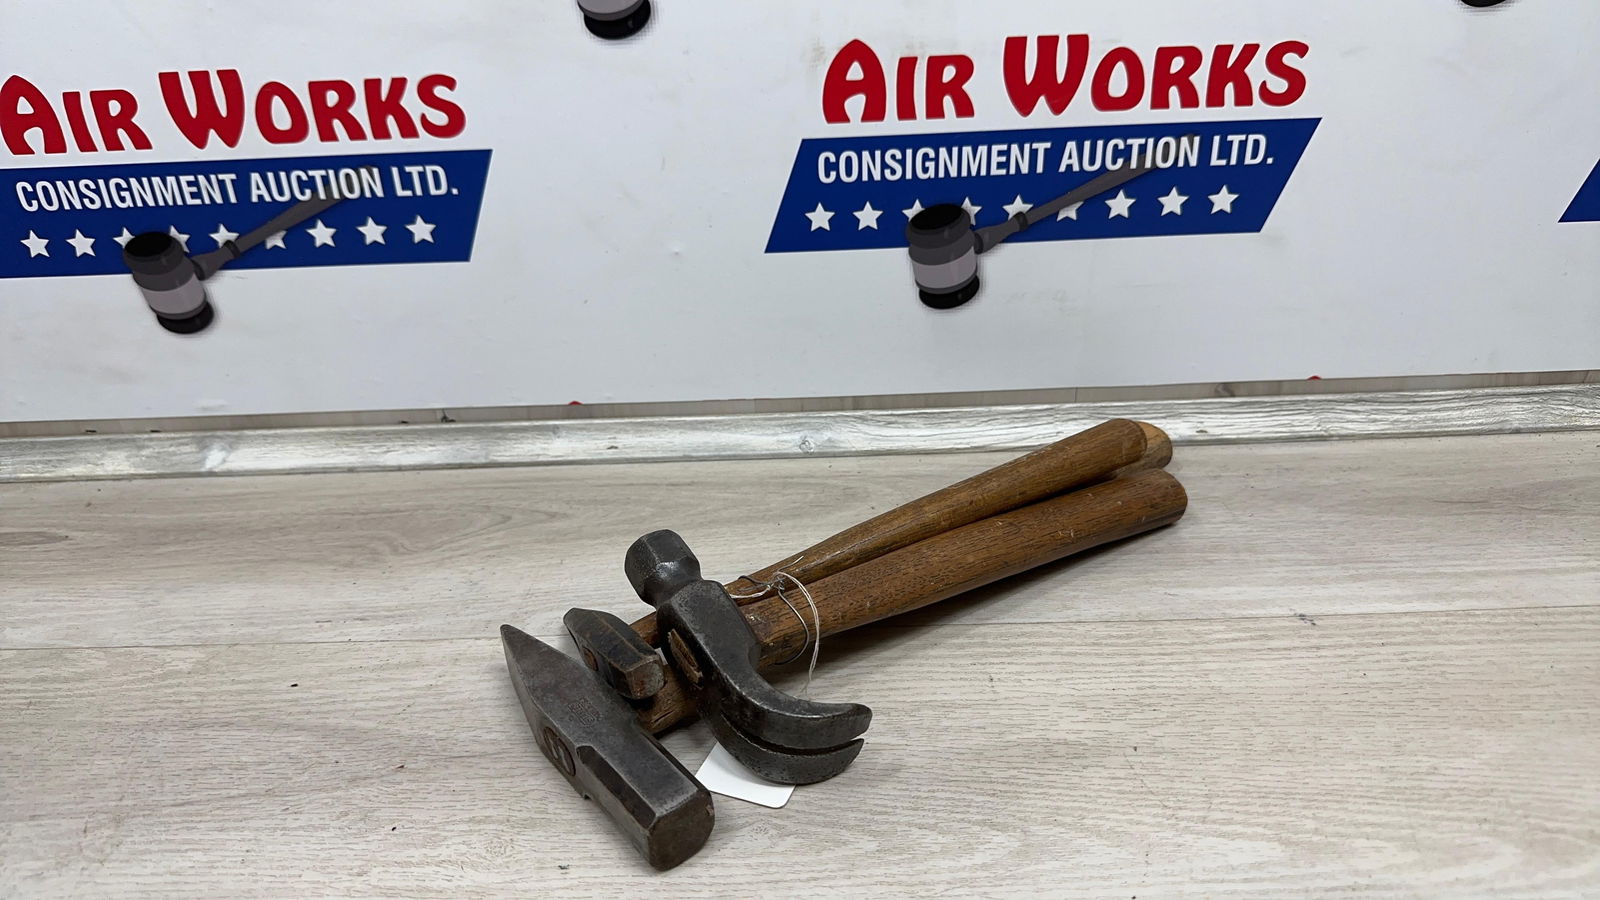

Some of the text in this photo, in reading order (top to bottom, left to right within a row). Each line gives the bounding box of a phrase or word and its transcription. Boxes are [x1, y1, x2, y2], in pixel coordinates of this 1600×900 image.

[0, 70, 465, 155] AIR WORKS
[822, 34, 1310, 124] AIR WORKS
[16, 165, 459, 212] CONSIGNMENT AUCTION LTD.
[818, 134, 1275, 184] CONSIGNMENT AUCTION LTD.
